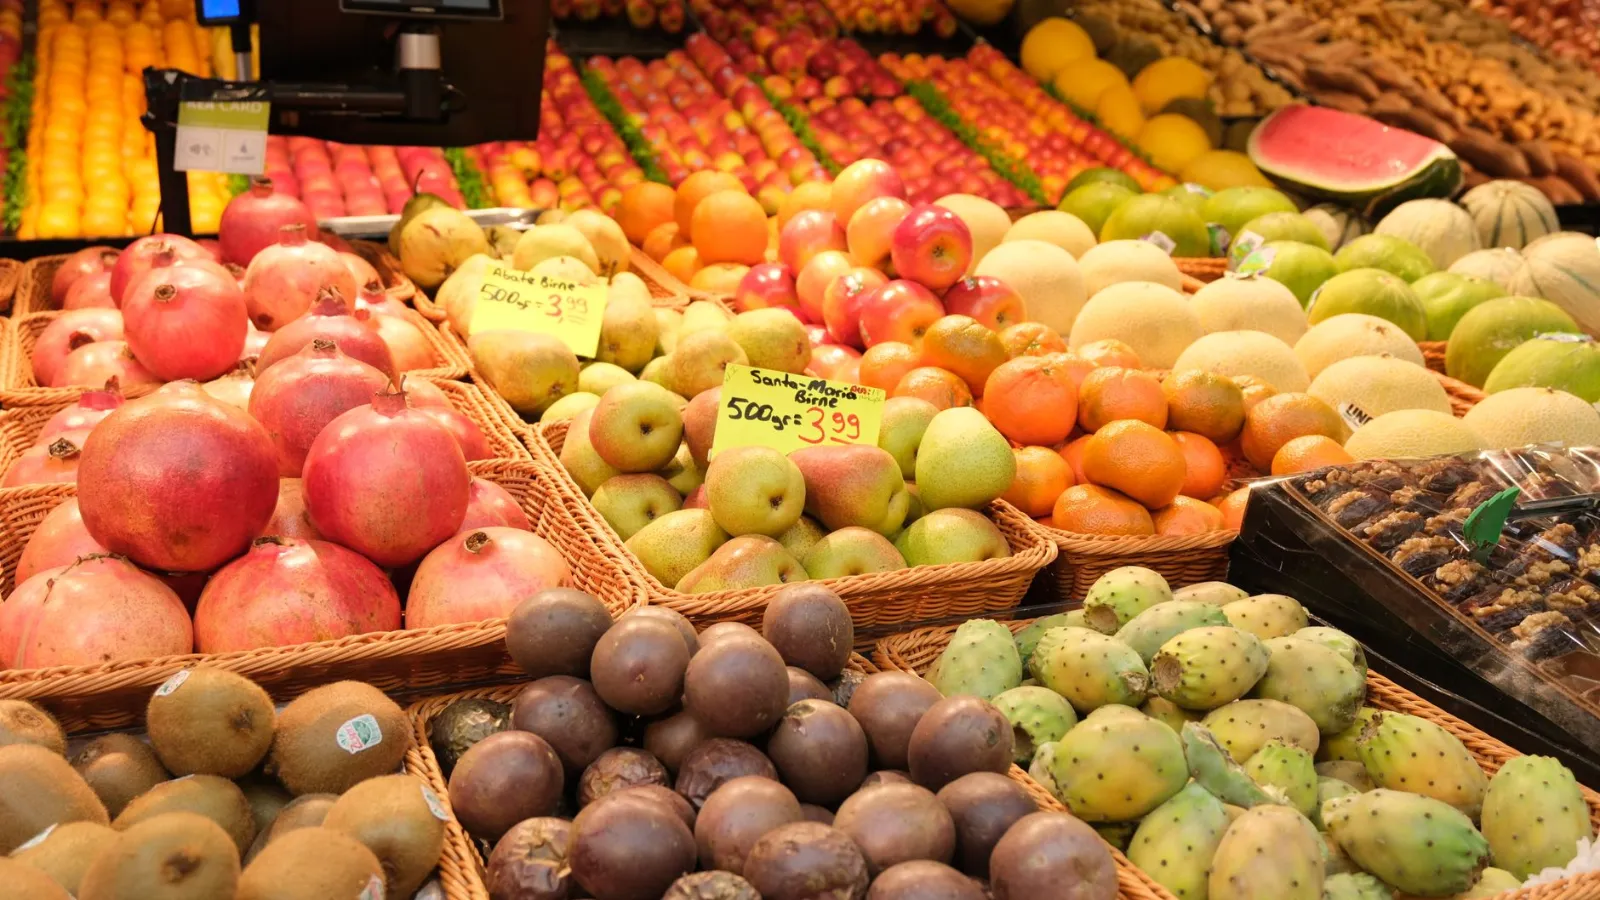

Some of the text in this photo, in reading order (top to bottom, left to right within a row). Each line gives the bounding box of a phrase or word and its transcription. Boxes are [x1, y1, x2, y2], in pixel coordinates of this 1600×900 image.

[493, 267, 576, 291] Abate Birne
[750, 370, 857, 401] Santa-Maria
[794, 389, 839, 409] Birne
